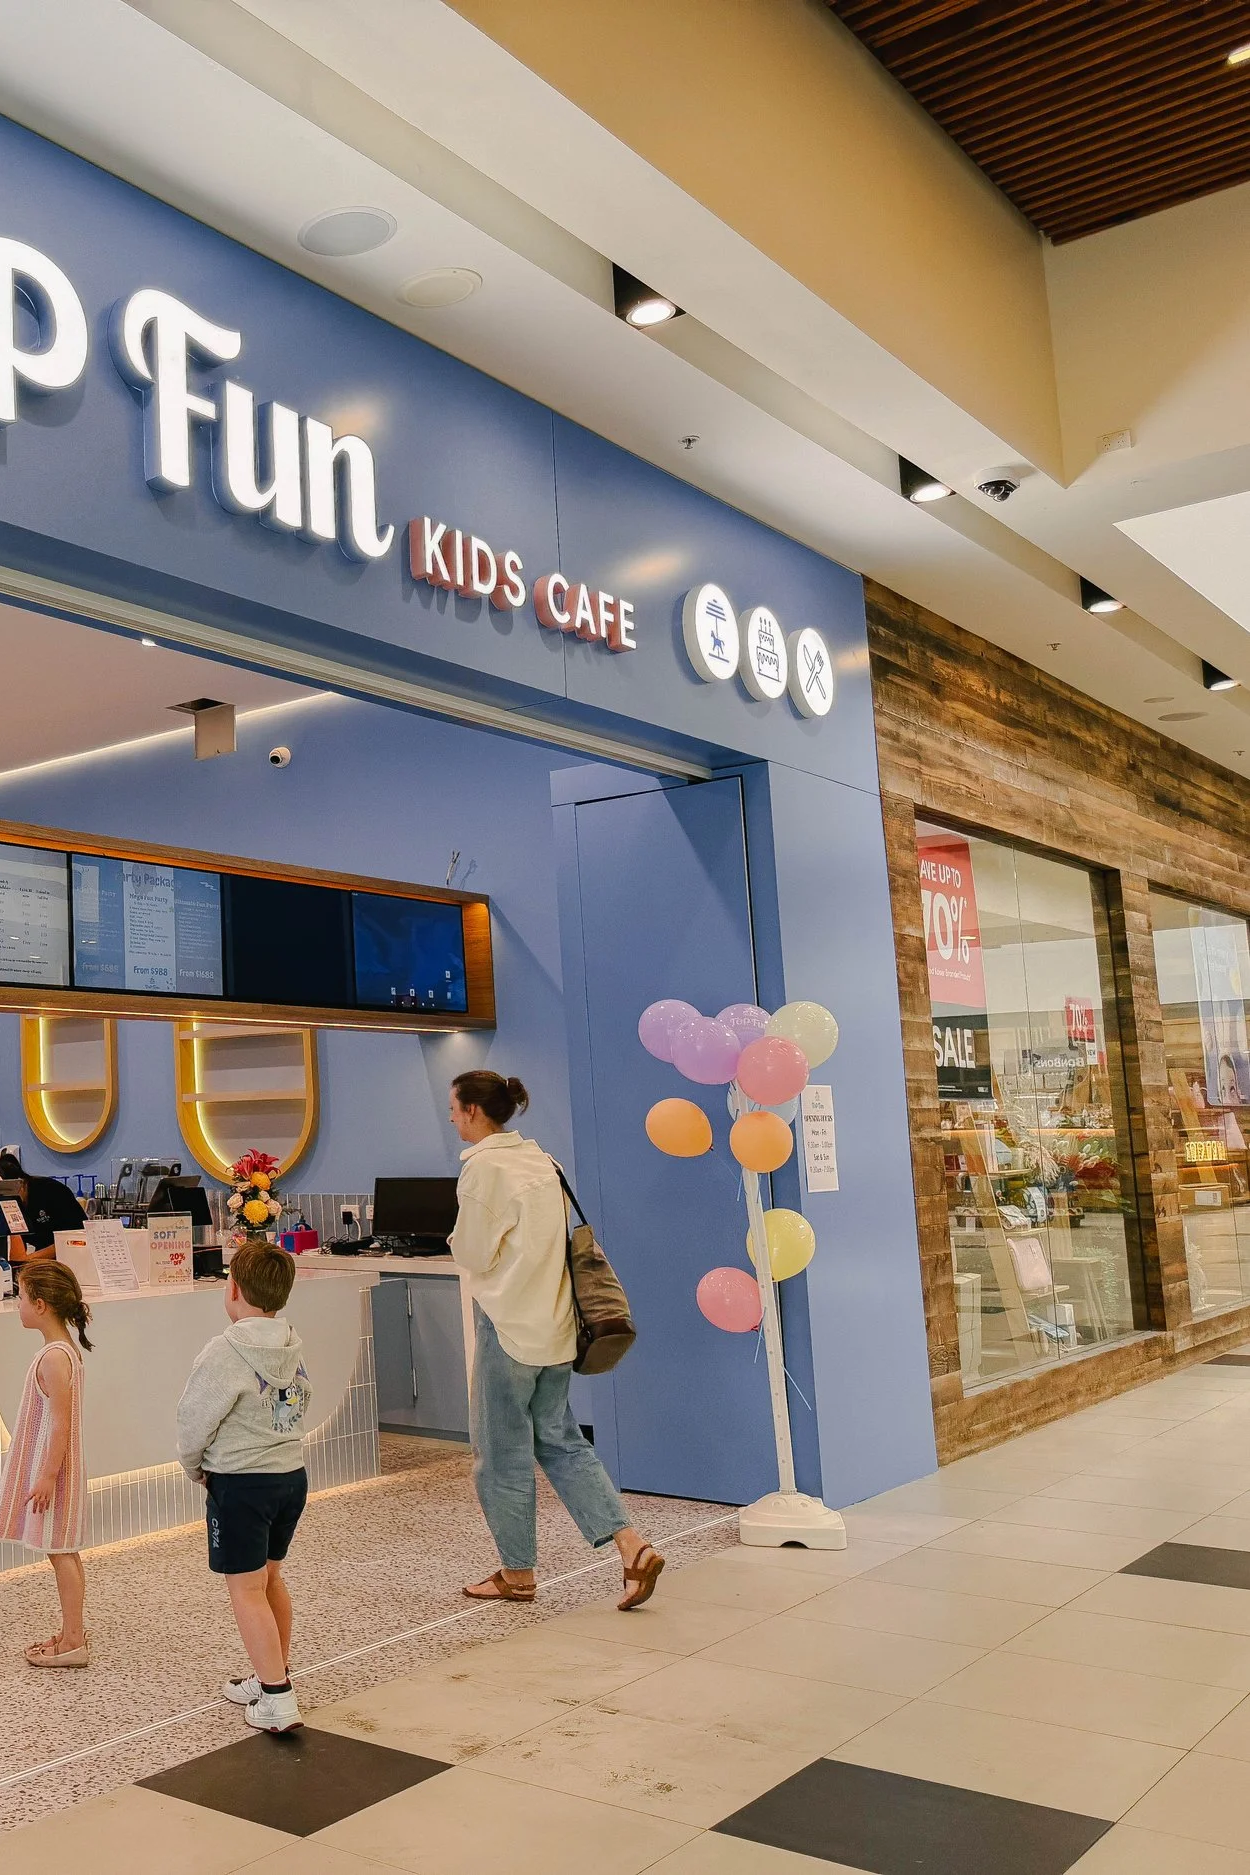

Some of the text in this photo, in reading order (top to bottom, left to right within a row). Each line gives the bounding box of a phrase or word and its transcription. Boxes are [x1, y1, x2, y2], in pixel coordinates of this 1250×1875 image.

[116, 288, 395, 563] Fun
[418, 516, 637, 652] KIDS CAFE
[120, 871, 175, 893] arty Packag
[920, 859, 962, 888] AVE UP TO
[133, 965, 168, 977] From $988
[932, 1025, 976, 1069] SALE
[150, 1240, 191, 1251] OPENING
[153, 1230, 178, 1240] SOFT
[169, 1252, 186, 1261] 20%
